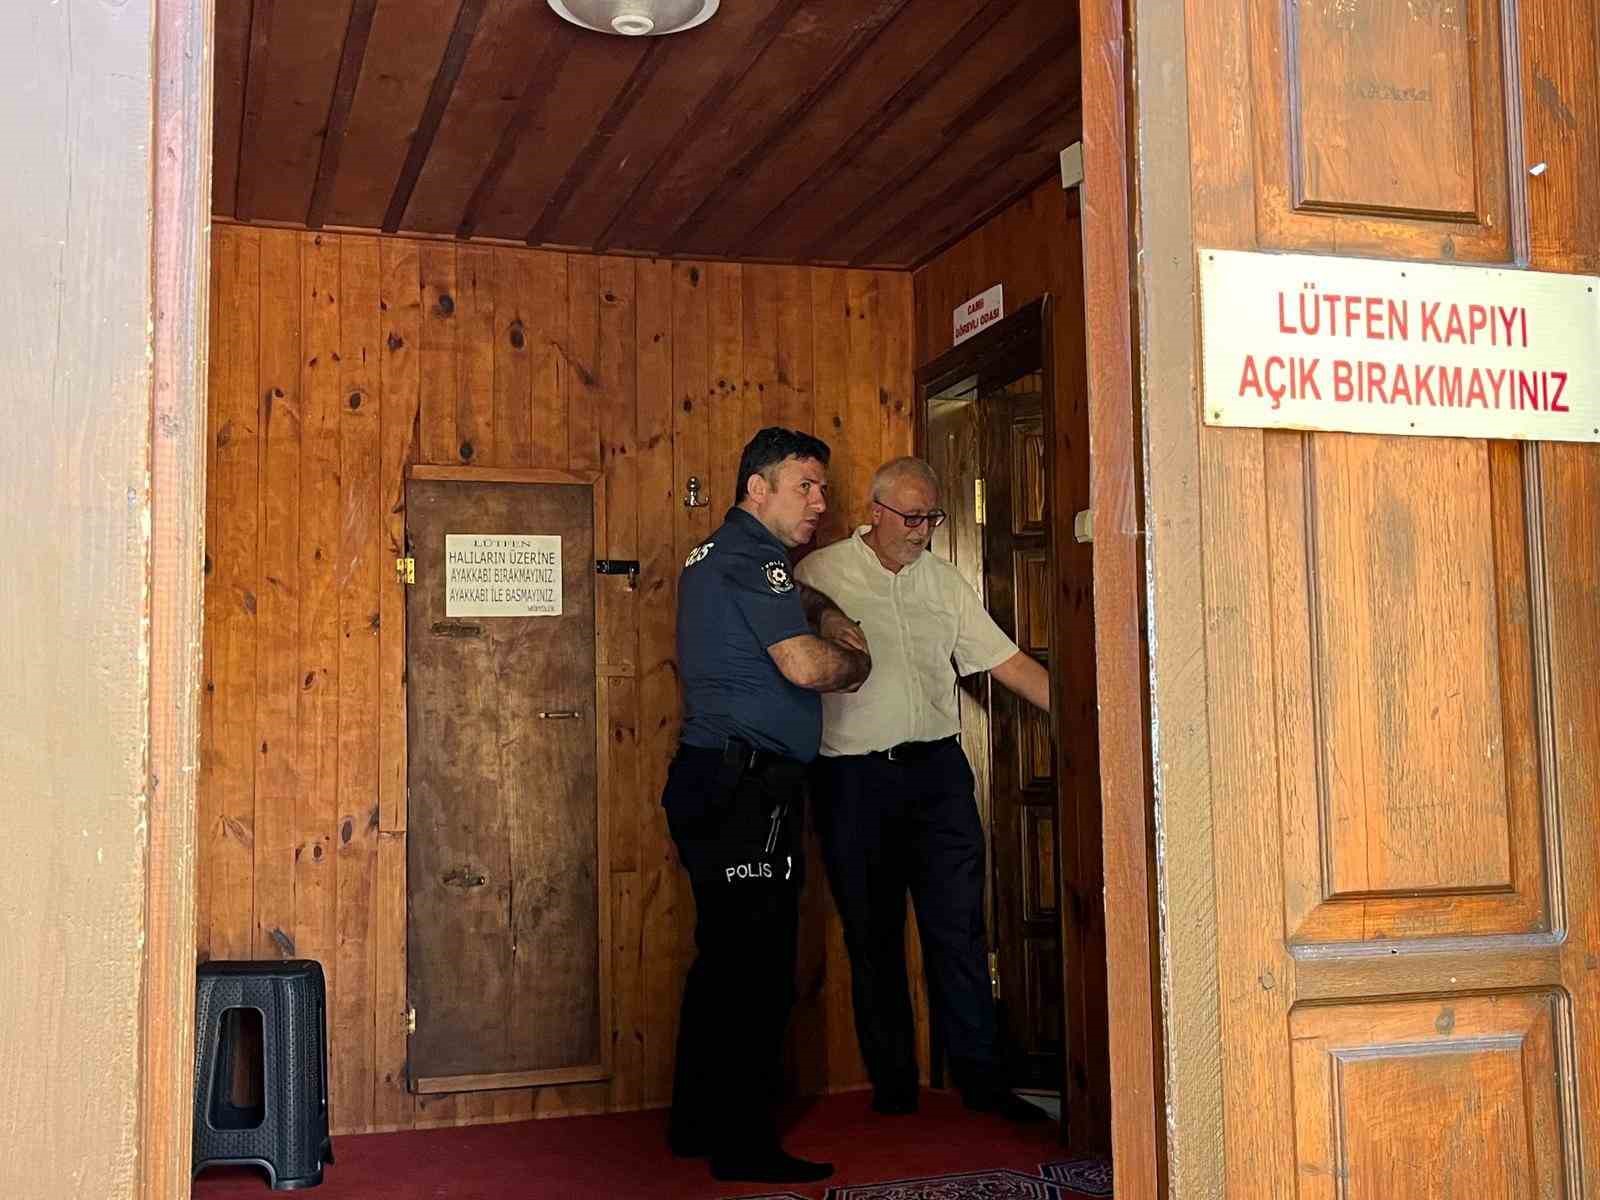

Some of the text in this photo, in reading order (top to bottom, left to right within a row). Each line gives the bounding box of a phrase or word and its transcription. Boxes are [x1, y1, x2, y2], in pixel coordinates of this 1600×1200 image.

[1278, 282, 1528, 348] LÜTFEN KAPIYI
[1238, 354, 1570, 413] AÇIK BIRAKMAYINIZ
[448, 548, 555, 565] HALILARIN ÜZERİNE
